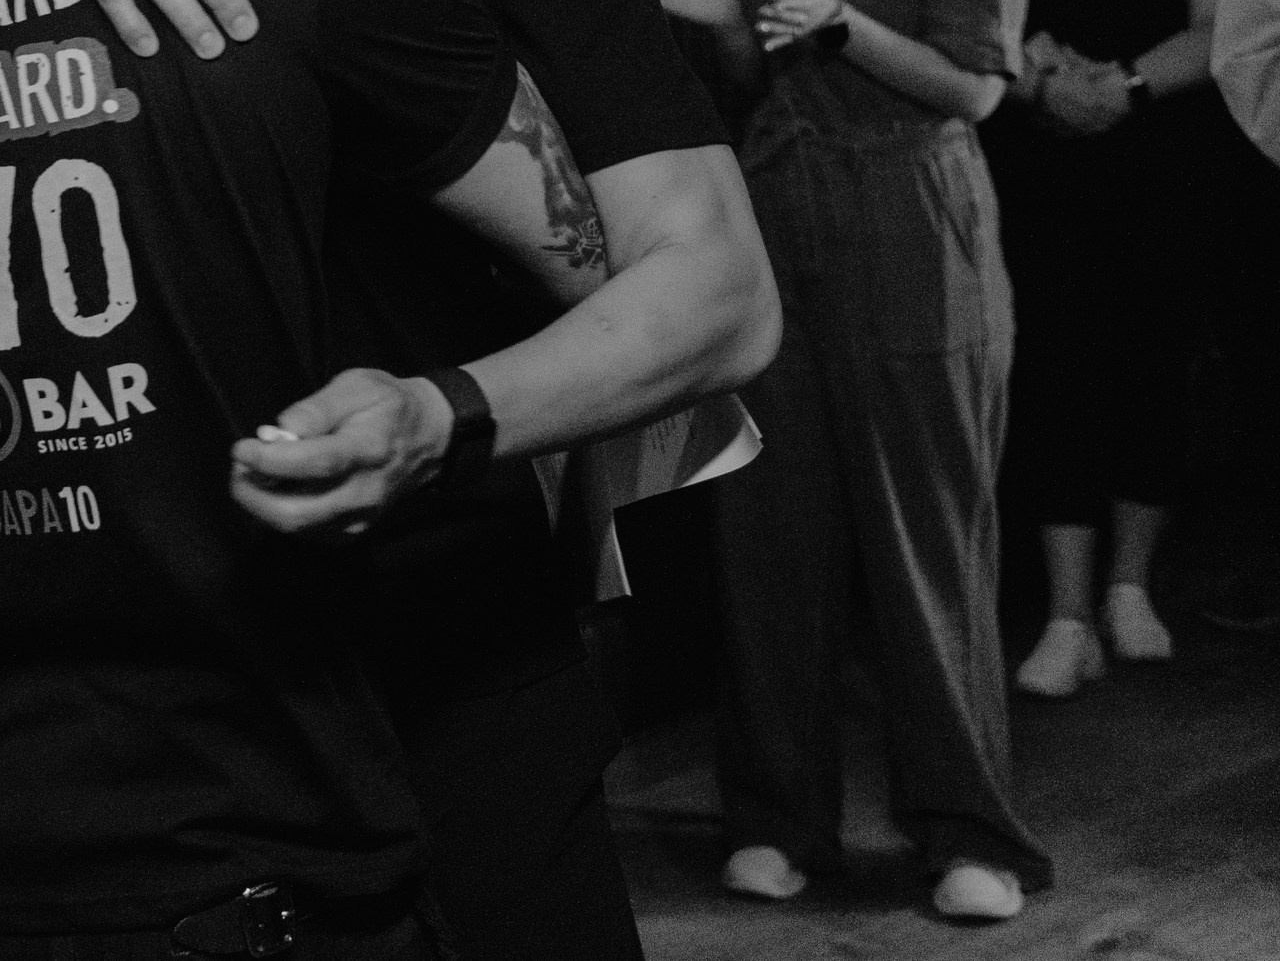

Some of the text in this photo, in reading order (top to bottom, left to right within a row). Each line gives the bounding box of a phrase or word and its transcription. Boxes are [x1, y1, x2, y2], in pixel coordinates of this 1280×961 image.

[22, 362, 157, 433] BAR
[37, 427, 134, 454] SINCE 2015
